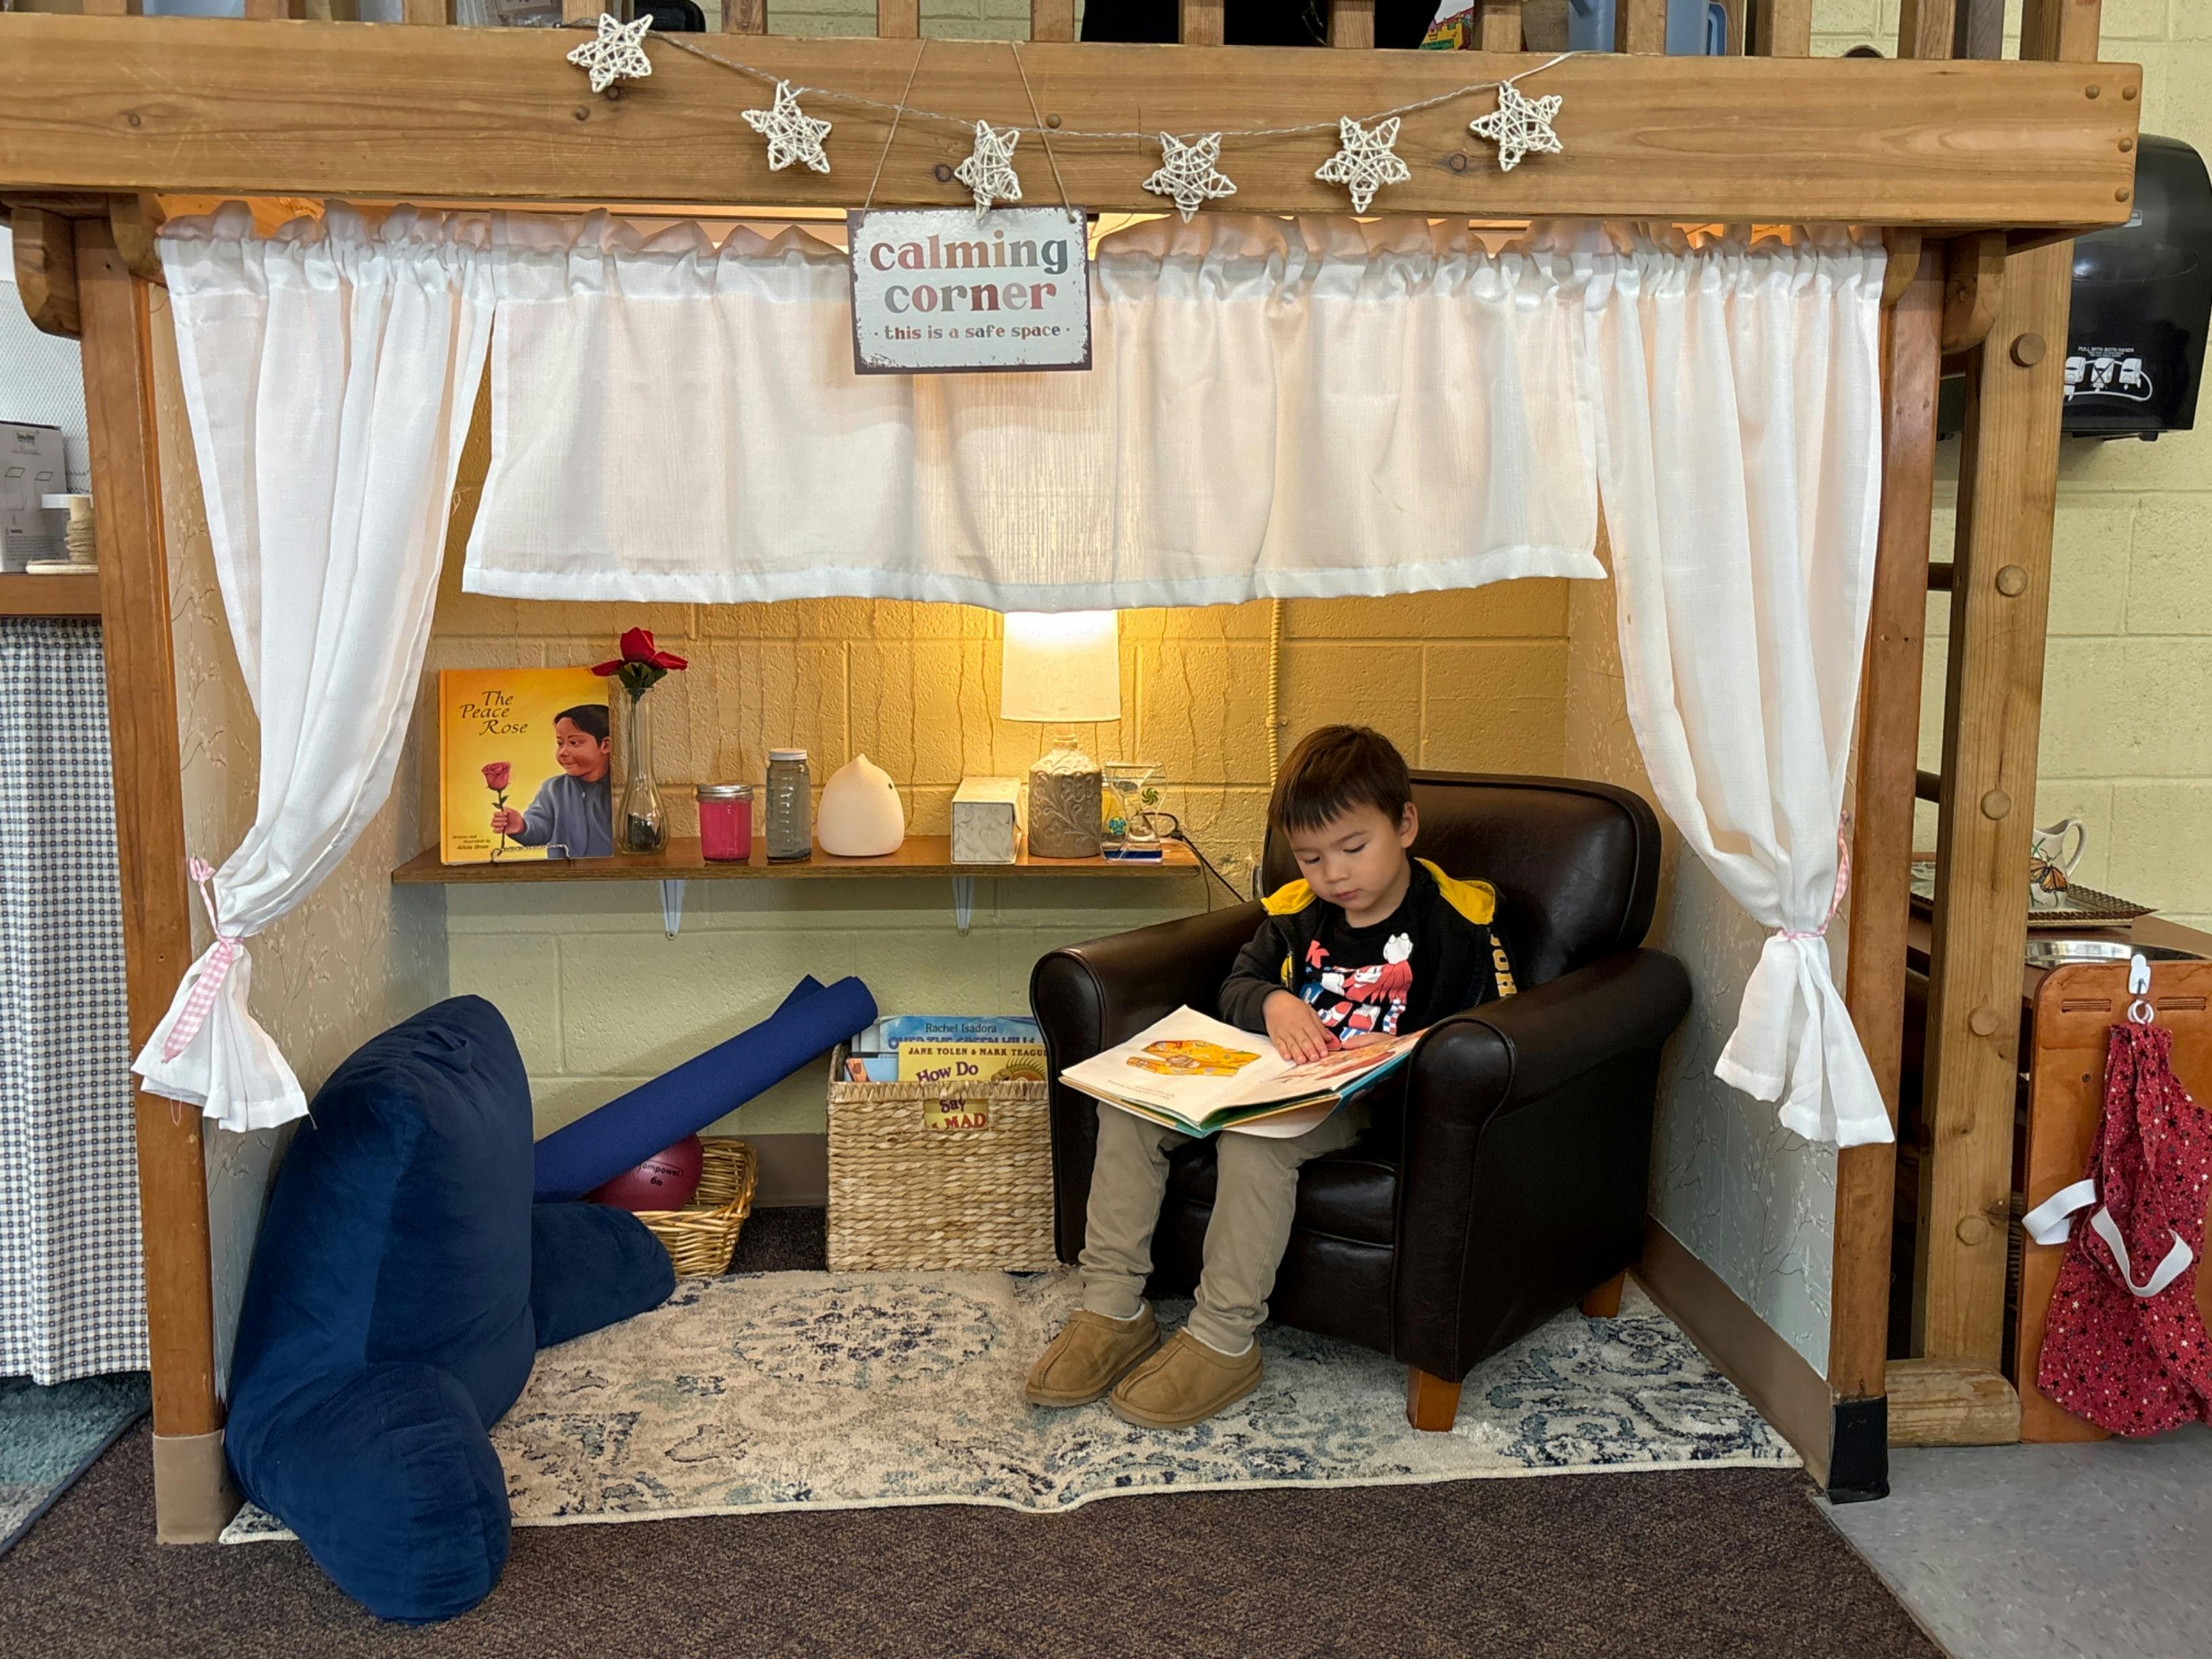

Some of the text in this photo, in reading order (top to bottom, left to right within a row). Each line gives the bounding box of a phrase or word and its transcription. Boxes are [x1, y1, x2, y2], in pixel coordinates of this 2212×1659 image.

[869, 229, 1068, 275] calming
[884, 282, 1057, 314] corner
[884, 325, 1061, 340] this is a safe space
[481, 691, 514, 705] The
[459, 703, 510, 719] Peace
[479, 720, 528, 736] Rose
[925, 1023, 997, 1033] Rachel Isadora
[908, 1047, 933, 1055] JANE
[937, 1047, 968, 1056] YOLEN
[979, 1048, 1007, 1056] MARK
[956, 1061, 979, 1076] Do
[939, 1097, 966, 1113] Say
